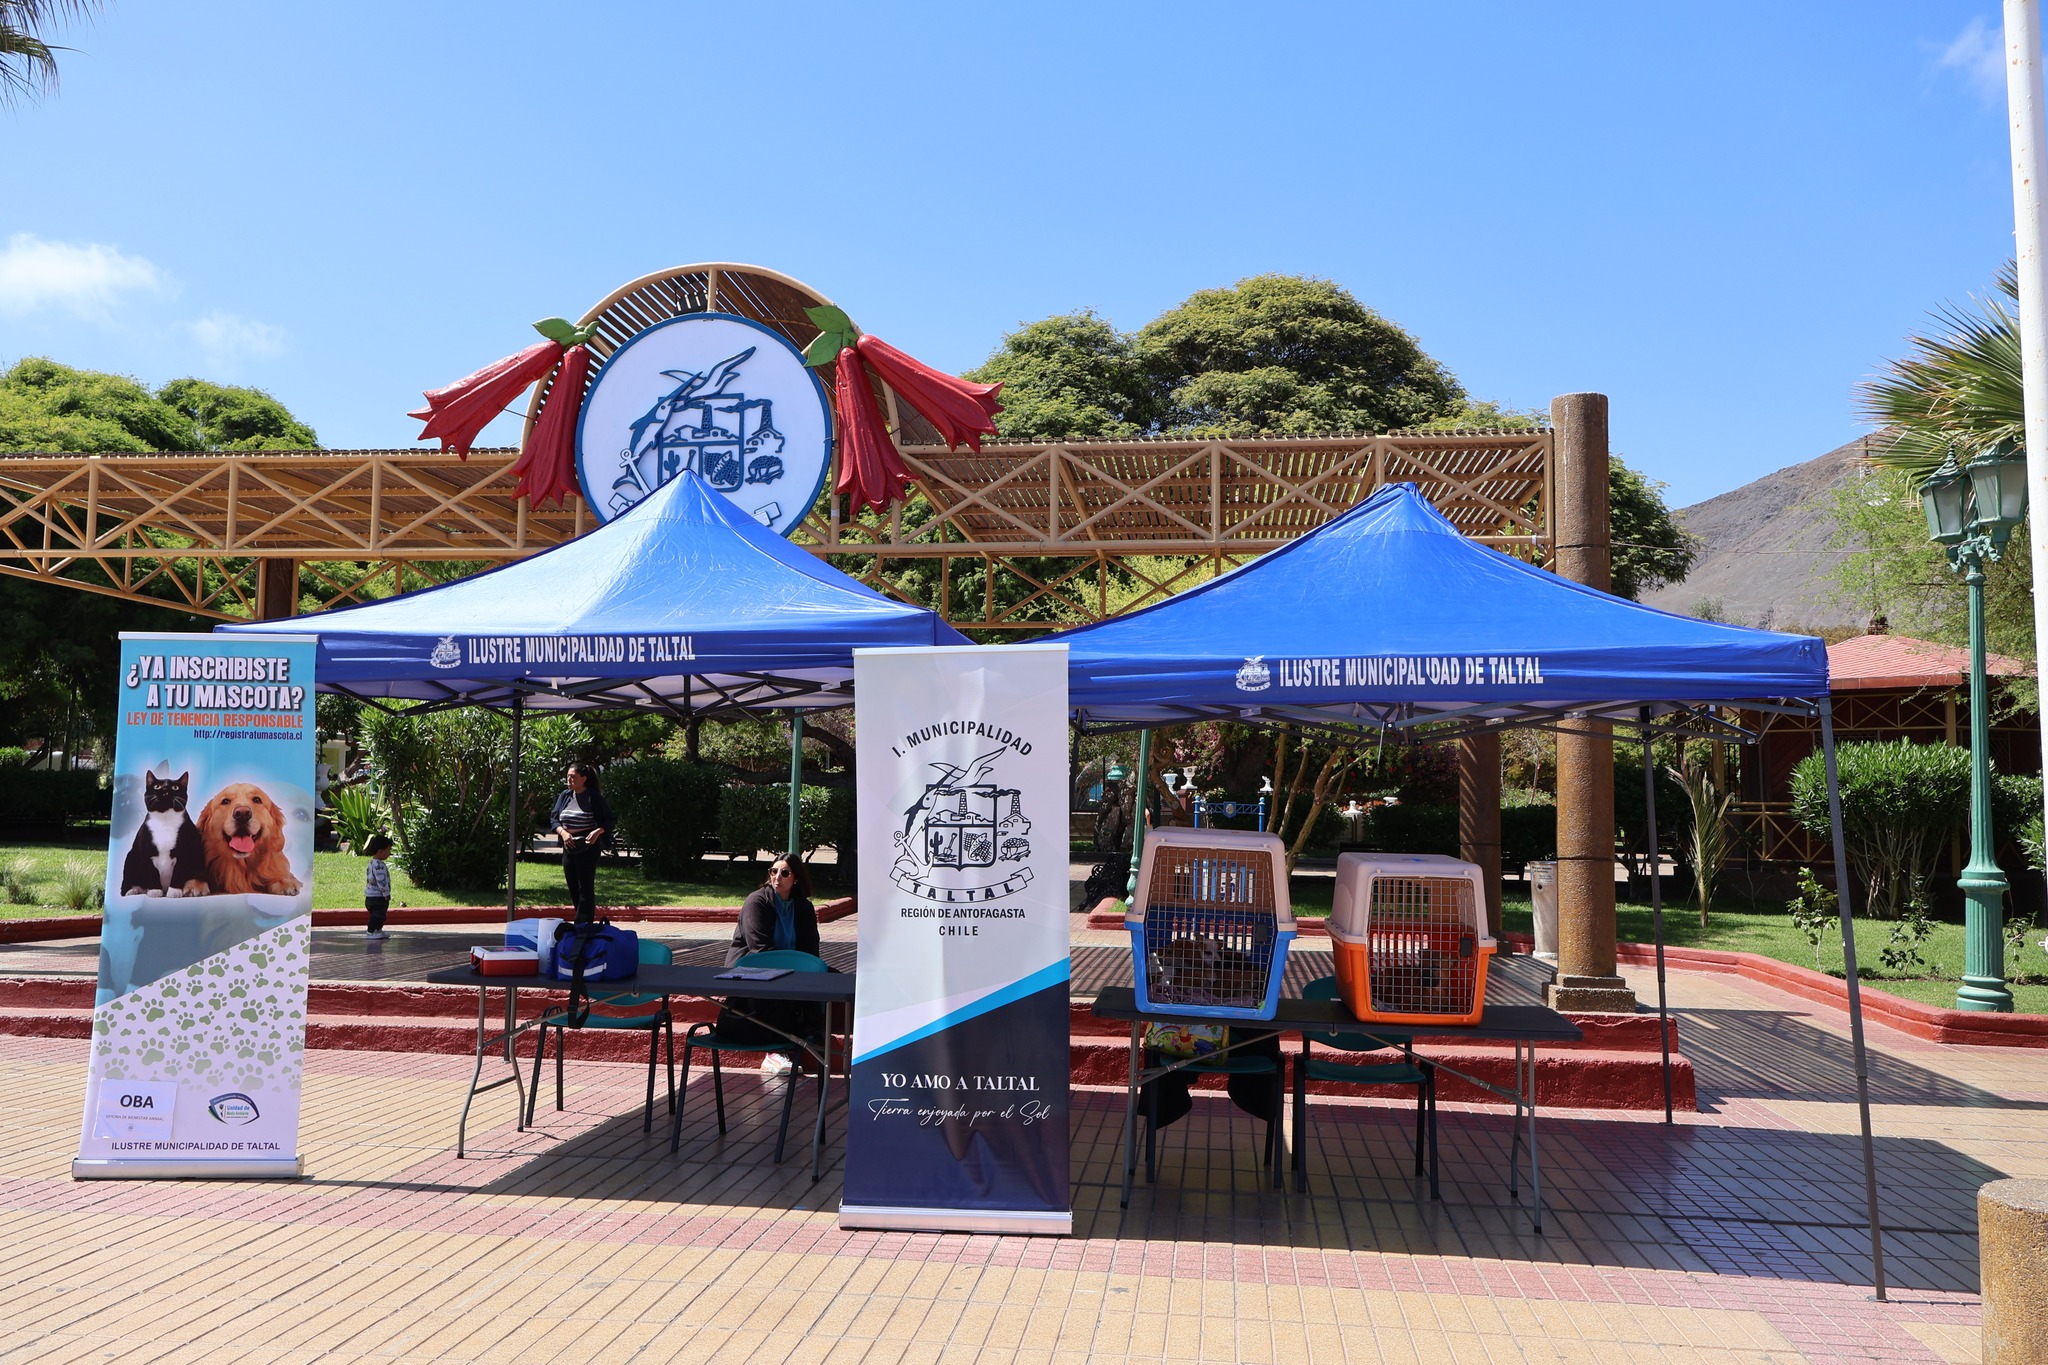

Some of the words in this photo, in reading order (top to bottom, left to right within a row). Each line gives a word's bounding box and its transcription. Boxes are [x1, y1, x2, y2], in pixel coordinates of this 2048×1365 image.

[468, 637, 521, 664] ILUSTRE
[525, 636, 624, 663] MUNICIPALIDAD
[628, 637, 646, 663] DE
[649, 636, 696, 662] TALTAL
[127, 656, 165, 688] ¿YA
[169, 656, 288, 681] INSCRIBISTE
[1279, 659, 1341, 687] ILUSTRE
[1465, 657, 1484, 685] DE
[1488, 657, 1544, 684] TALTAL
[147, 684, 159, 707] A
[165, 684, 190, 708] TU
[194, 685, 303, 711] MASCOTA?
[127, 712, 147, 726] LEY
[150, 713, 164, 726] DE
[167, 713, 220, 727] TENENCIA
[223, 714, 303, 729] RESPONSABLE
[193, 729, 303, 741] http://registratumascota.cl
[891, 746, 907, 758] I.
[906, 721, 1033, 756] MUNICIPALIDAD
[912, 882, 1015, 902] TALTAL
[901, 905, 936, 919] REGIÓN
[937, 908, 951, 919] DE
[953, 908, 1026, 919] ANTOFAGASTA
[938, 926, 979, 936] CHILE
[881, 1073, 907, 1088] YO
[911, 1074, 951, 1090] AMO
[955, 1076, 969, 1090] A
[973, 1075, 1040, 1091] TALTAL
[120, 1094, 154, 1109] OBA
[868, 1098, 913, 1121] Tierra
[917, 1103, 970, 1127] enjoyada
[969, 1108, 996, 1127] por
[1000, 1104, 1015, 1119] el
[1019, 1100, 1051, 1126] Sol
[111, 1141, 152, 1151] ILUSTRE
[154, 1142, 229, 1151] MUNICIPALIDAD
[231, 1142, 245, 1151] DE
[247, 1142, 281, 1151] TALTAL
